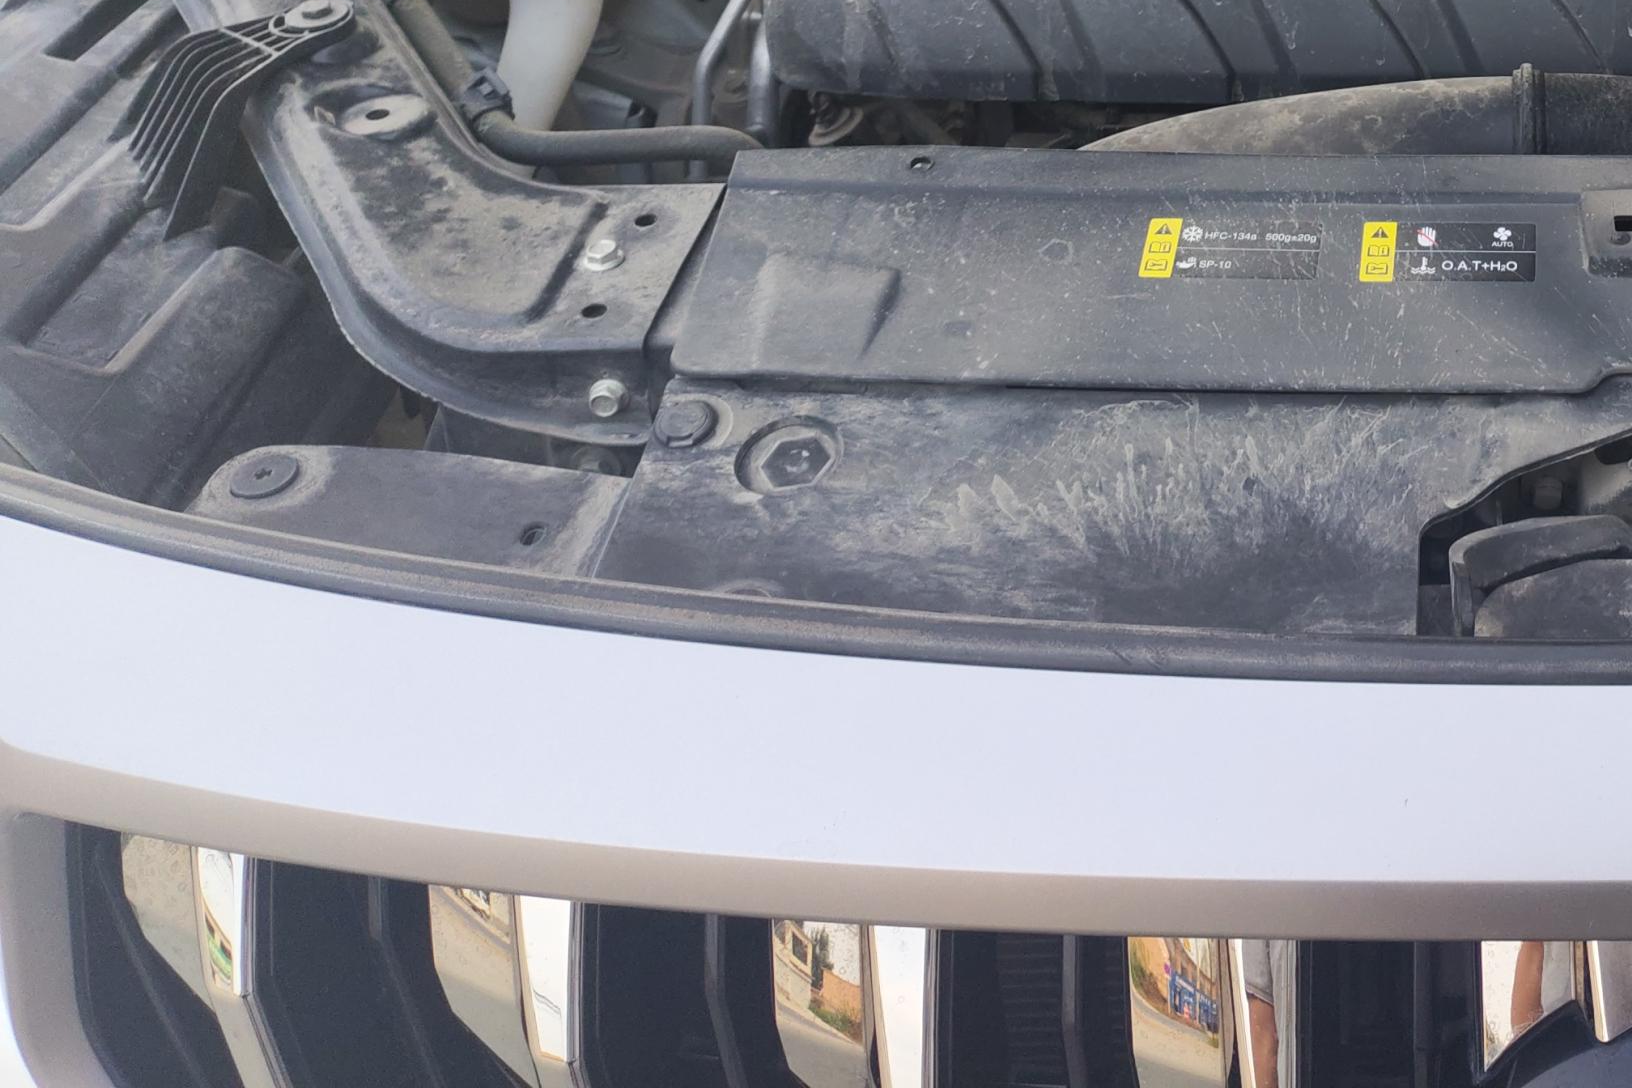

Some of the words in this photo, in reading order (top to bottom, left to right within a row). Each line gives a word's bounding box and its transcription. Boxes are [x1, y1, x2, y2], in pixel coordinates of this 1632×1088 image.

[1203, 229, 1258, 241] HFC-134a
[1265, 231, 1318, 243] 500g±20g
[1491, 240, 1515, 248] AUTO
[1198, 258, 1232, 269] SP-10
